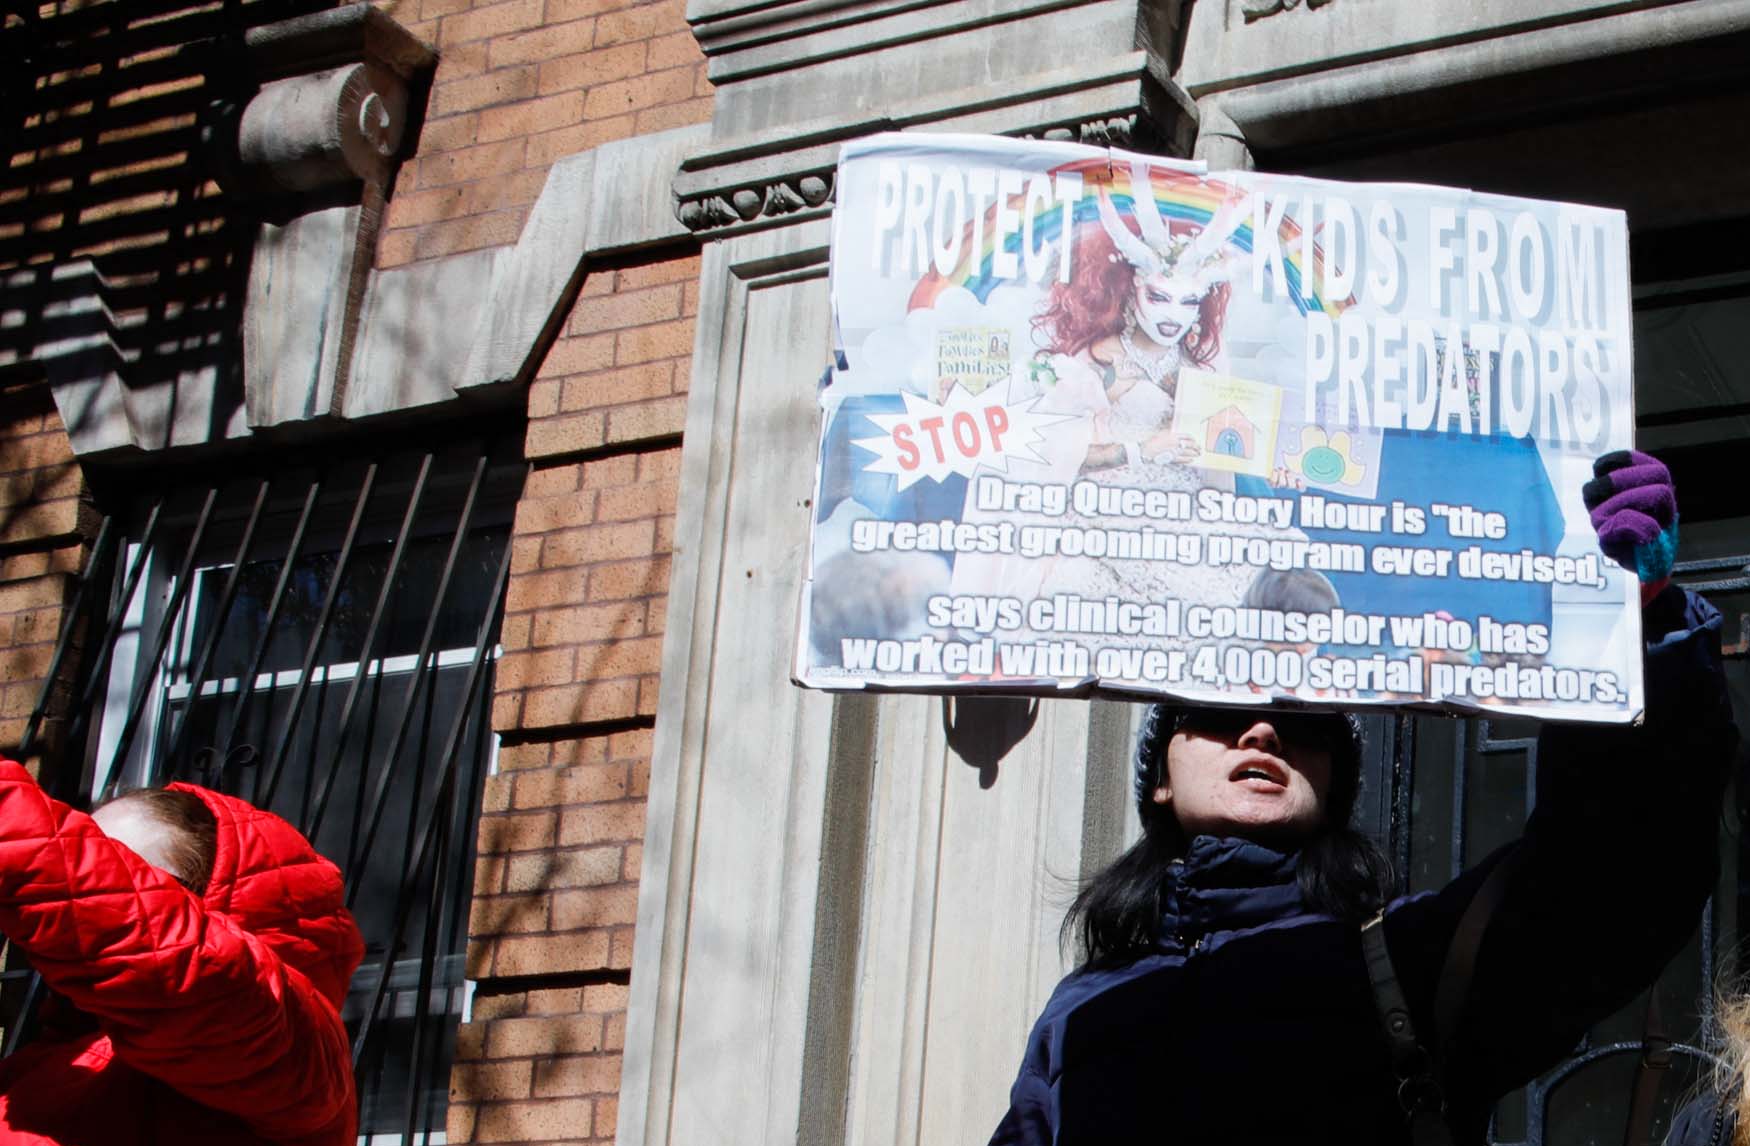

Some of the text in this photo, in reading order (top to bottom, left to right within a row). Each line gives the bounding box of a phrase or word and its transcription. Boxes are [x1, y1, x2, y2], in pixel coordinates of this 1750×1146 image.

[872, 162, 1609, 326] PROTECT KIDS FROM
[1304, 310, 1606, 444] PREDATORS
[892, 404, 1010, 472] STOP
[977, 476, 1067, 518] Drag
[1072, 480, 1192, 521] Queen
[1197, 489, 1294, 529] Story
[1300, 494, 1387, 533] Hour
[1391, 501, 1426, 535] is
[851, 518, 1015, 553] greatest
[1019, 523, 1201, 565] grooming
[1206, 537, 1366, 573] program
[1371, 546, 1452, 578] ever
[926, 594, 1550, 656] says clinical counselor who has
[840, 635, 1628, 703] worked with over 4,000 serial predators.
